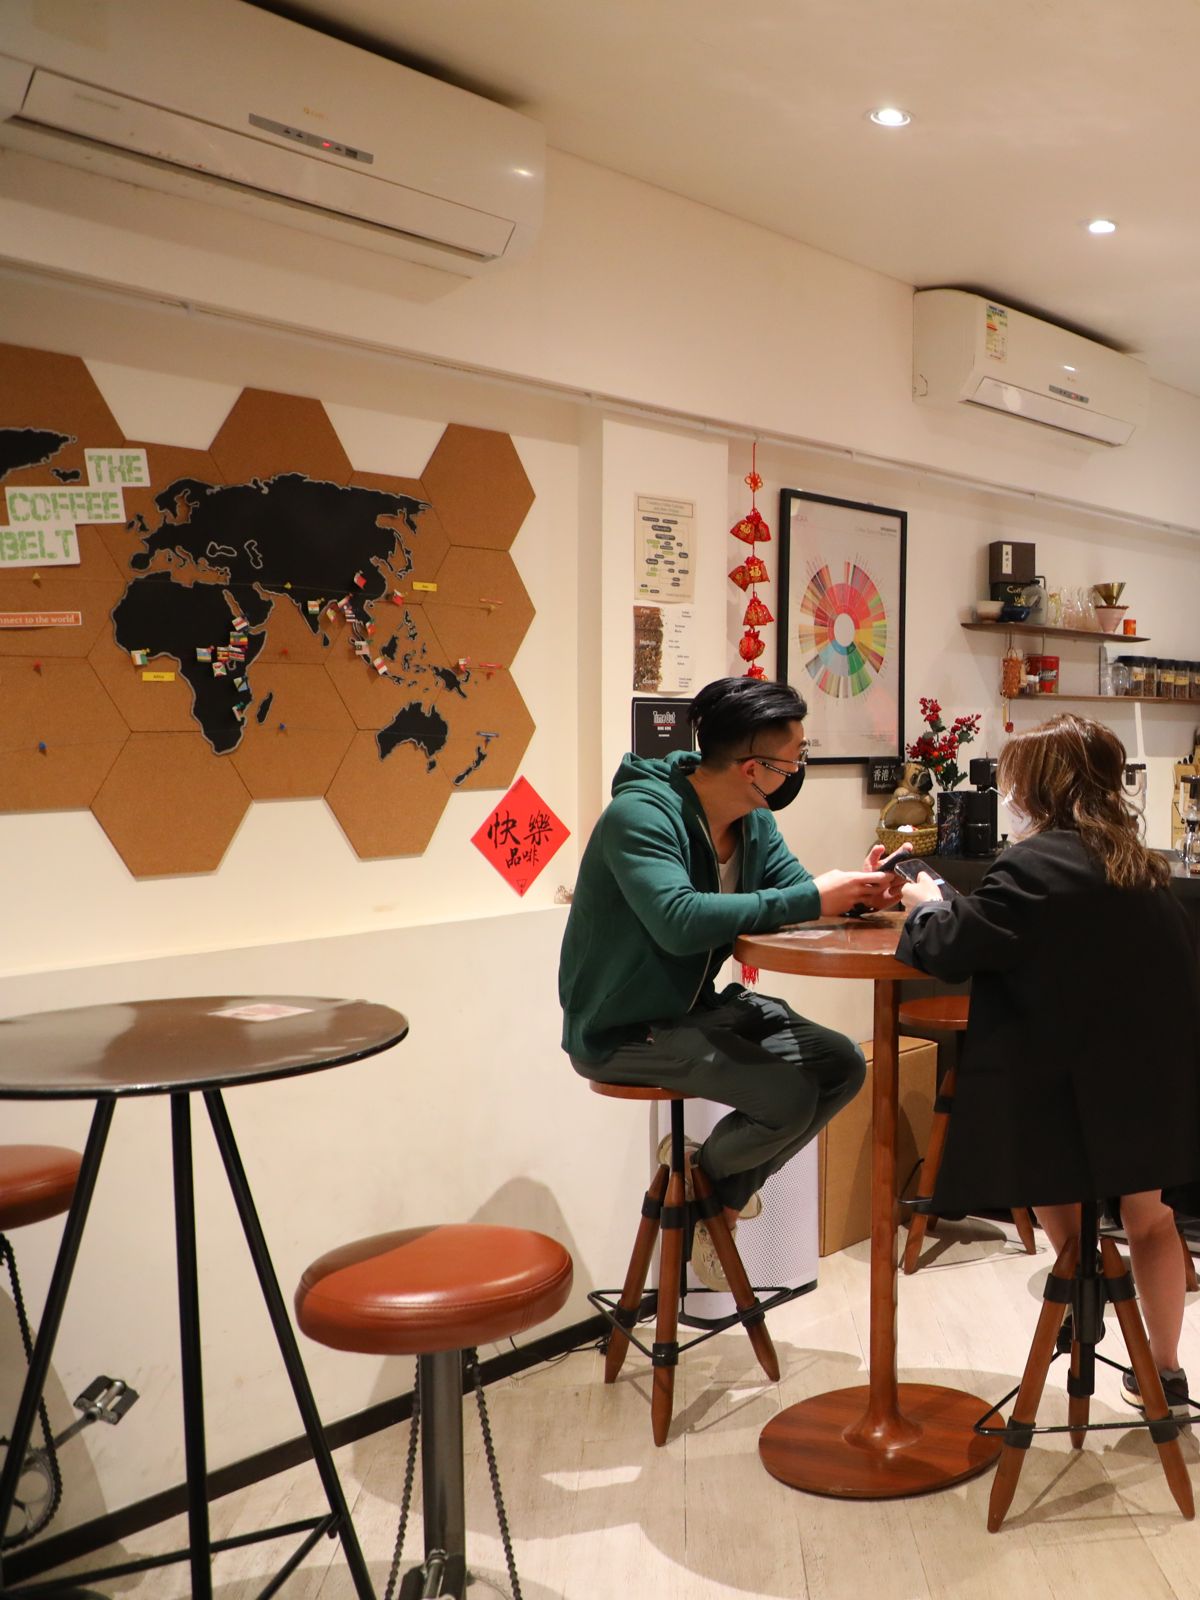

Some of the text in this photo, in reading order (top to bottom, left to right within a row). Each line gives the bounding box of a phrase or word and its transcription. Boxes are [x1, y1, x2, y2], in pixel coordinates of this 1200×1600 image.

[87, 455, 144, 483] THE
[8, 491, 120, 521] COFFEE
[0, 529, 73, 560] BELT
[36, 615, 49, 624] the
[51, 614, 75, 623] world
[486, 810, 553, 849] 快樂
[505, 844, 540, 869] 品啡
